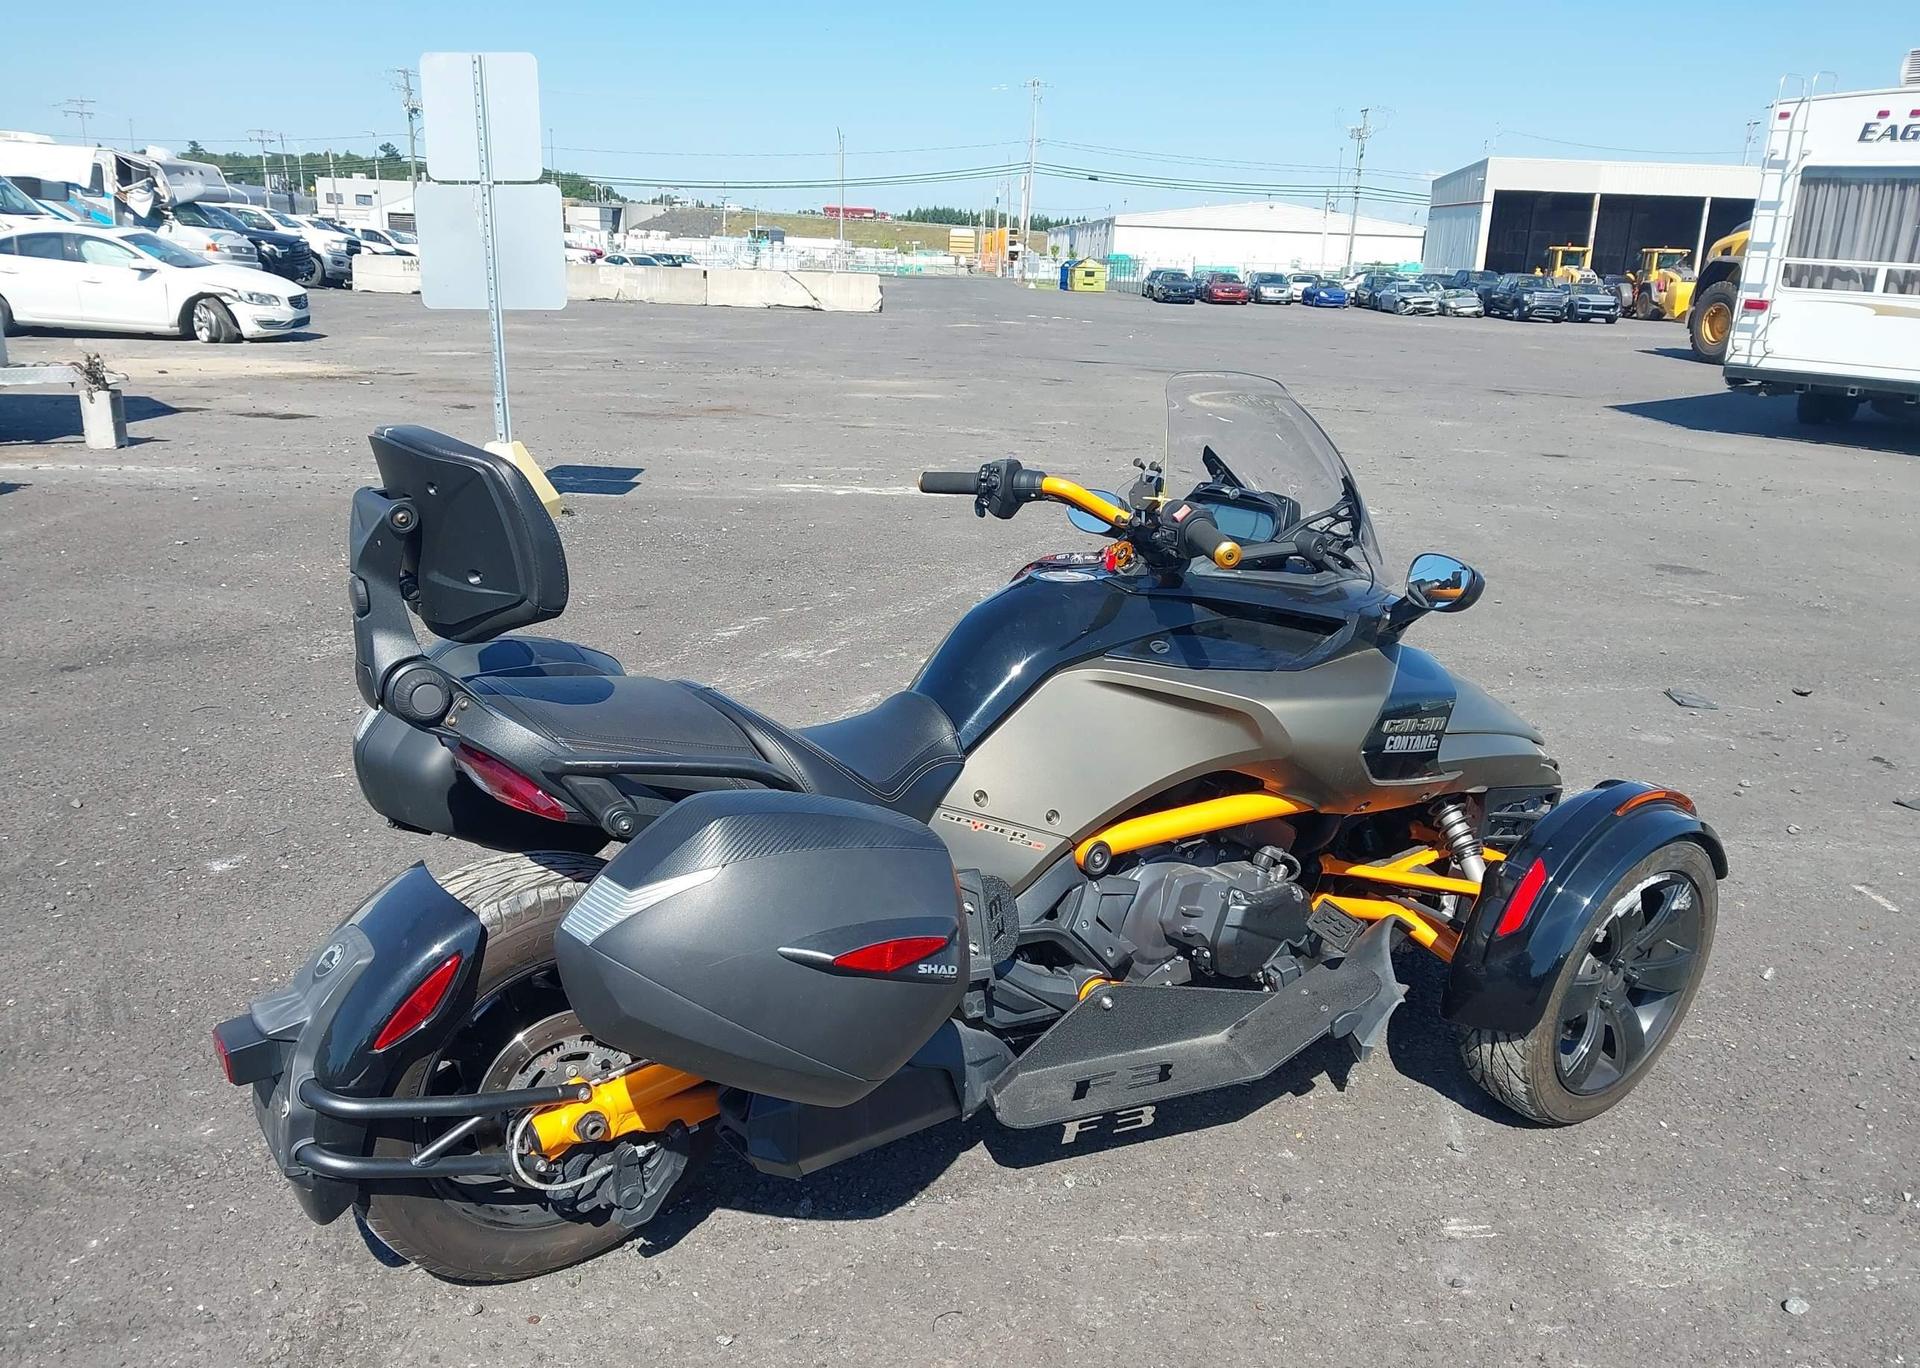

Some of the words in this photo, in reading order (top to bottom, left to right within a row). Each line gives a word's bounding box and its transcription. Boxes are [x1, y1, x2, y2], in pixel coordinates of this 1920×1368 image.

[941, 812, 1027, 840] SPYDER
[917, 963, 958, 975] SHAD
[1070, 1060, 1173, 1102] F3
[1061, 1105, 1156, 1145] F3
